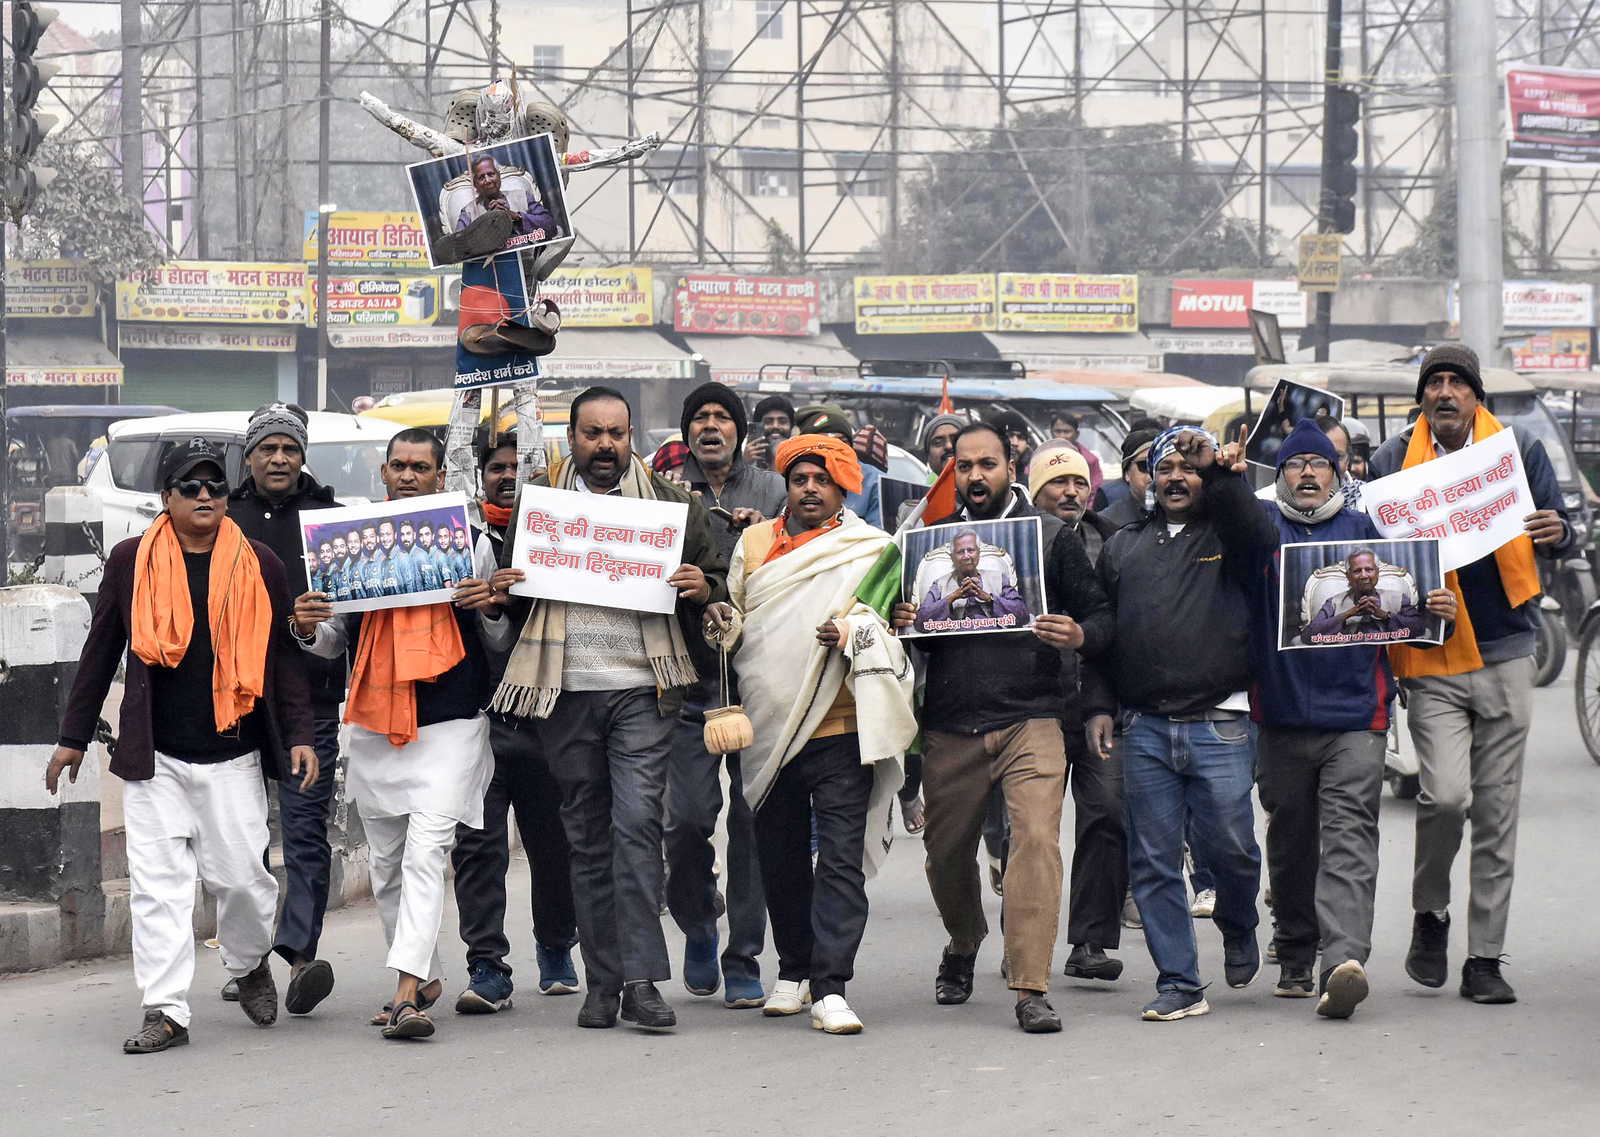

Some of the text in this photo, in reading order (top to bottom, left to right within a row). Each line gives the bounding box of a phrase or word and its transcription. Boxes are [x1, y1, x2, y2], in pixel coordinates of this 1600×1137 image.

[23, 267, 51, 282] मटन
[168, 265, 208, 285] होटल
[227, 270, 262, 287] मटन
[267, 271, 304, 287] हाउस
[585, 275, 621, 287] होटल
[1018, 283, 1035, 298] जय
[1040, 279, 1051, 297] श्री
[1056, 283, 1070, 297] राम
[1179, 295, 1247, 312] MOTUL
[493, 363, 513, 380] शर्म
[513, 360, 535, 376] करो
[1378, 454, 1514, 526] हिंदू की हत्या नहीं
[1450, 491, 1518, 531] हिंदूस्तान
[526, 512, 678, 548] हिंदू की हत्या नहीं
[528, 548, 665, 581] सहेगा हिंदूस्तान
